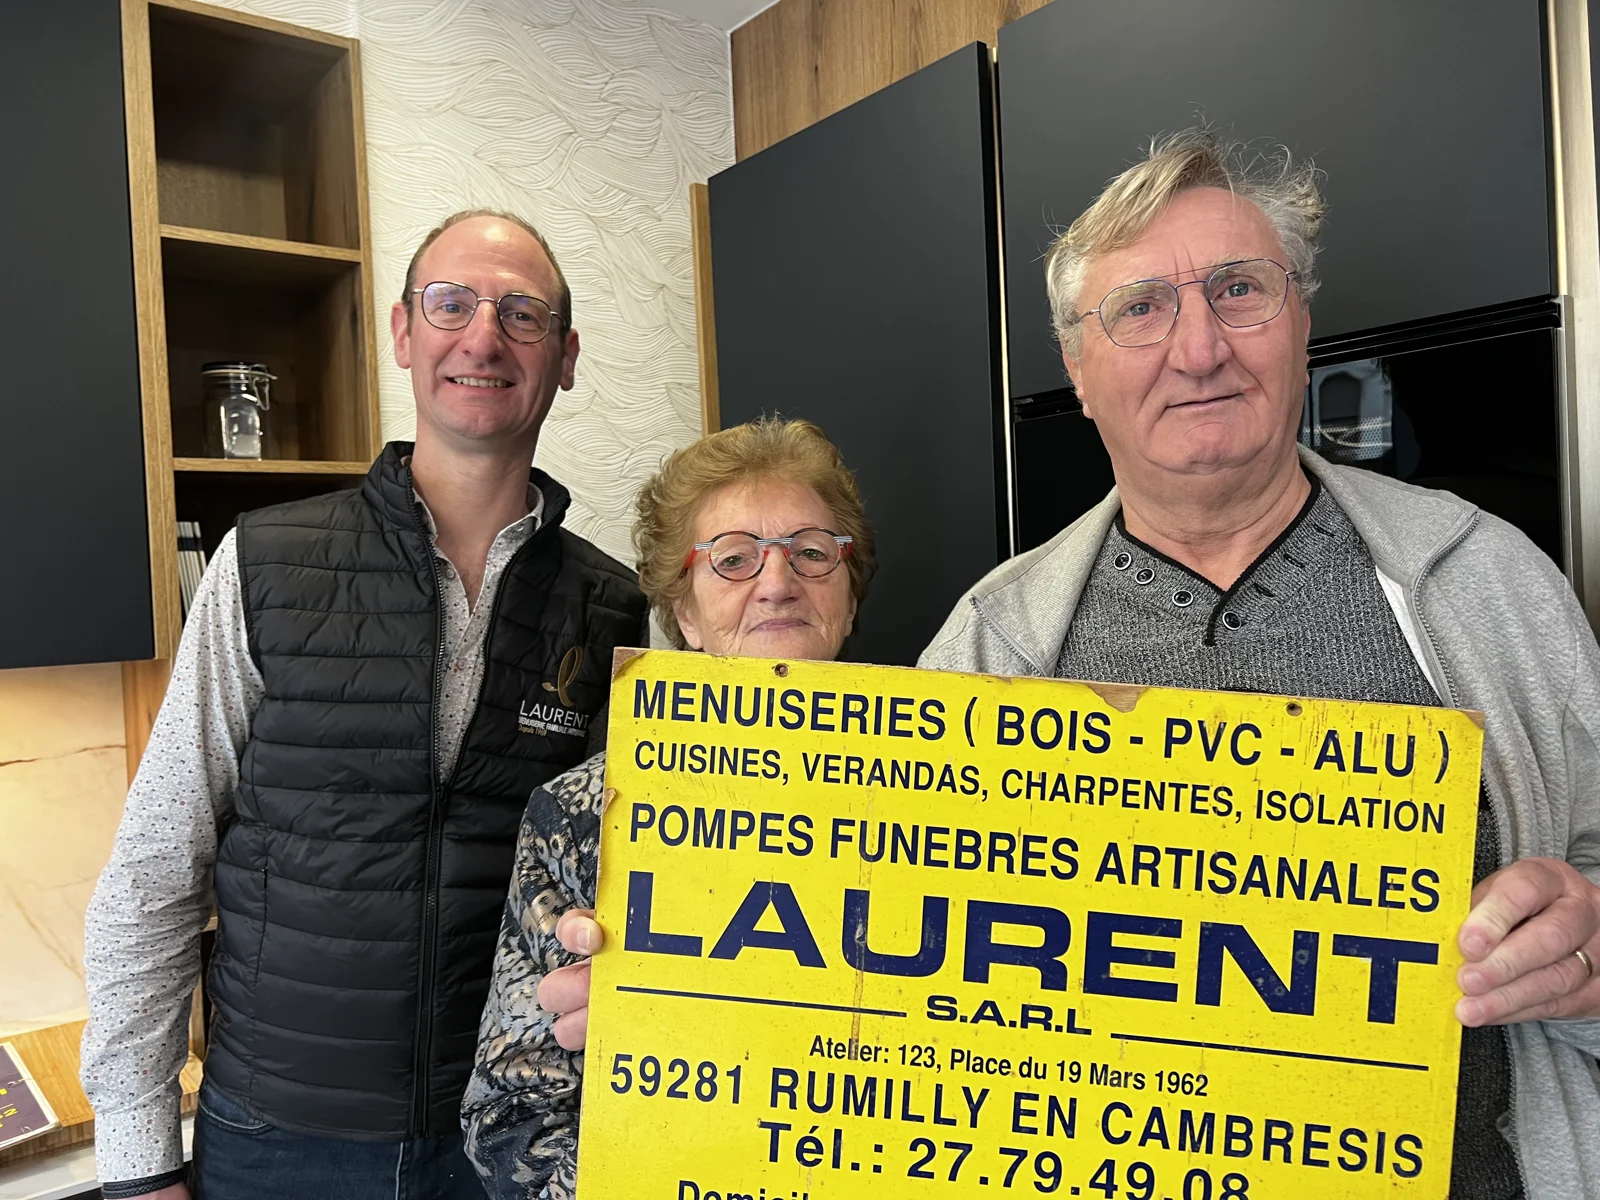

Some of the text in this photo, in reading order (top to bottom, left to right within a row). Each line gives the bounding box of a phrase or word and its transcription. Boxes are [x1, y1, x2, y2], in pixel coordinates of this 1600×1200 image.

[519, 699, 590, 729] LAURENT
[633, 679, 1450, 784] MENUISERIES ( BOIS - PVC - ALU )
[634, 740, 1446, 834] CUISINES, VERANDAS, CHARPENTES, ISOLATION
[630, 802, 1440, 913] POMPES FUNEBRES ARTISANALES
[623, 870, 1440, 1025] LAURENT
[926, 994, 1092, 1036] S.A.R.L
[609, 1053, 1424, 1179] 59281 RUMILLY EN CAMBRESIS
[898, 1043, 942, 1074] 123,
[950, 1048, 1012, 1077] Place
[1018, 1056, 1048, 1080] du
[1056, 1060, 1082, 1084] 19
[1089, 1062, 1146, 1091] Mars
[1154, 1070, 1209, 1097] 1962
[906, 1137, 1250, 1200] 27.79.4908
